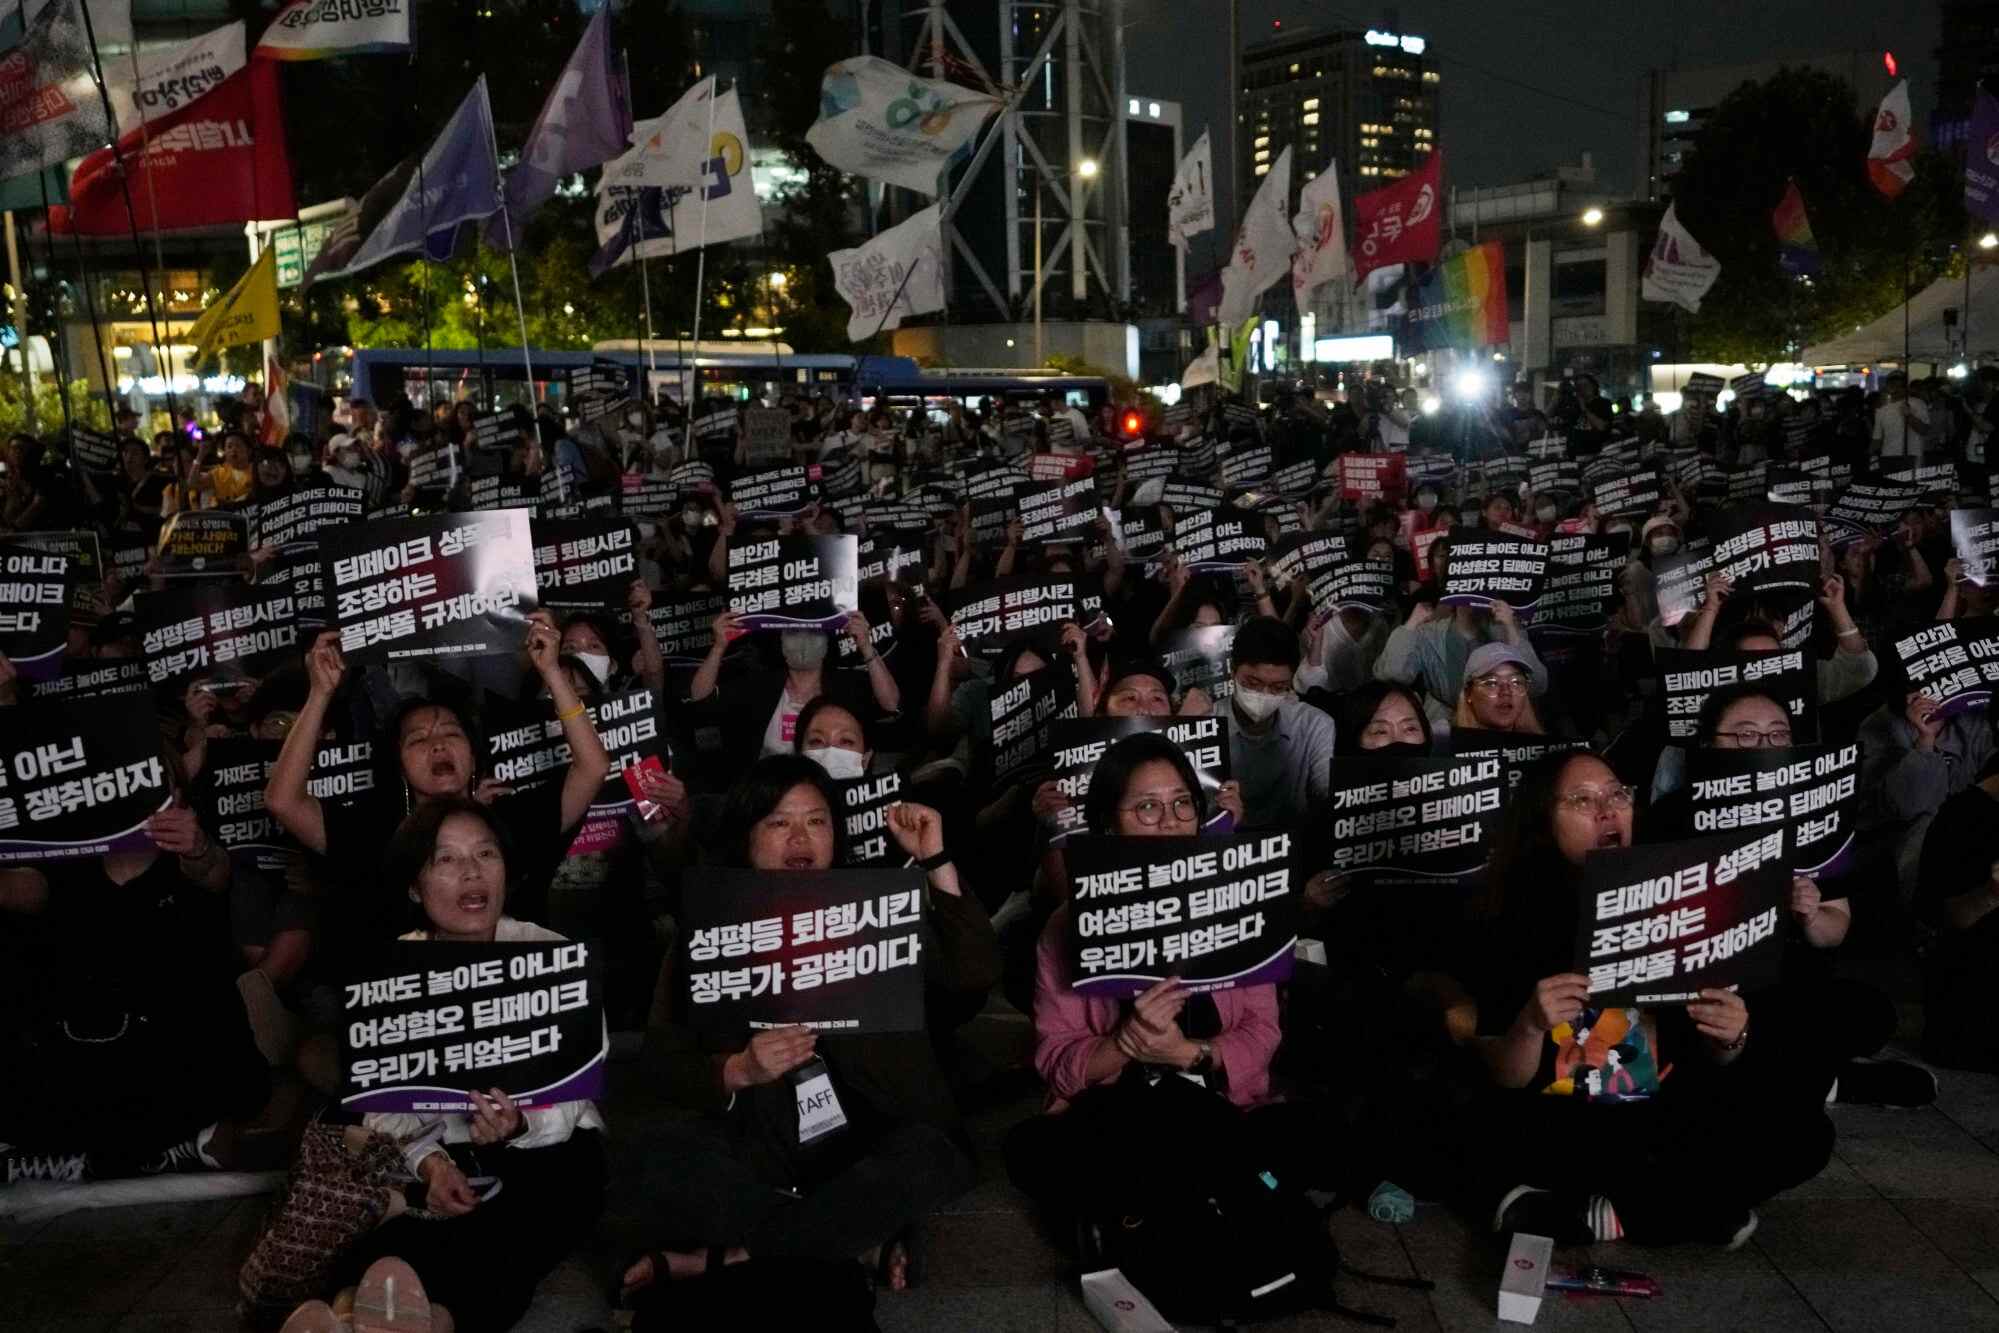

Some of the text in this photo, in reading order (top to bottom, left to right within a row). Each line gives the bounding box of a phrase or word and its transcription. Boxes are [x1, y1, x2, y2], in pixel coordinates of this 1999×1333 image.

[333, 518, 512, 587] 딥페이크 성폭
[561, 527, 632, 561] 퇴행시킨
[728, 540, 780, 568] 불안과
[1520, 543, 1549, 557] 아니다
[1713, 520, 1818, 563] 성평등 퇴행시킨
[1773, 543, 1820, 565] 공범이다
[7, 555, 69, 576] 아니다
[564, 552, 636, 586] 공범이다
[727, 557, 820, 592] 두려움 아닌
[1448, 559, 1500, 576] 여성혐오
[337, 573, 438, 620] 조장하는
[783, 579, 850, 607] 쟁취하
[951, 584, 1074, 623] 성평등 퇴행시킨
[143, 597, 294, 654] 성평등 퇴행시킨
[340, 609, 418, 653] 플랫폼
[1005, 604, 1075, 631] 공범이다
[147, 627, 299, 683] 정부가 공범이다
[1896, 622, 1958, 660] 불안과
[1906, 646, 1971, 682] 두려움
[1664, 651, 1804, 692] 딥페이크 성폭력
[489, 690, 654, 755] 가짜도 아니다
[1667, 694, 1708, 715] 조장
[1167, 718, 1220, 745] 아니다
[13, 735, 88, 781] 아닌
[494, 744, 574, 783] 여성혐오
[1692, 744, 1858, 801] 가짜도 놀이도 아니다
[24, 756, 165, 822] 쟁취하자
[307, 770, 375, 801] 페이크
[845, 772, 902, 807] 아니다
[1334, 758, 1501, 810] 가짜도 놀이도 아니다
[1694, 774, 1856, 832] 여성혐오 딥페이크
[1334, 787, 1501, 841] 여성혐오 딥페이크
[1074, 833, 1292, 900] 가짜도 놀이도 아니다
[1333, 821, 1483, 869] 우리가 뒤엎는다
[1596, 829, 1784, 921] 딥페이크 성폭력
[688, 889, 922, 962] 성평등 퇴행시킨
[1078, 868, 1290, 937] 여성혐오 딥페이크
[1080, 912, 1266, 974] 우리가 뒤엎는다
[1586, 905, 1778, 994] 플랫폼 규제하라
[1589, 906, 1707, 958] 조장하는
[344, 942, 589, 1009] 가짜도 놀이도 아니다
[690, 933, 922, 1004] 정부가 공범이다
[349, 979, 590, 1050] 여성혐오 딥페이크
[350, 1024, 563, 1088] 우리가 뒤엎는다
